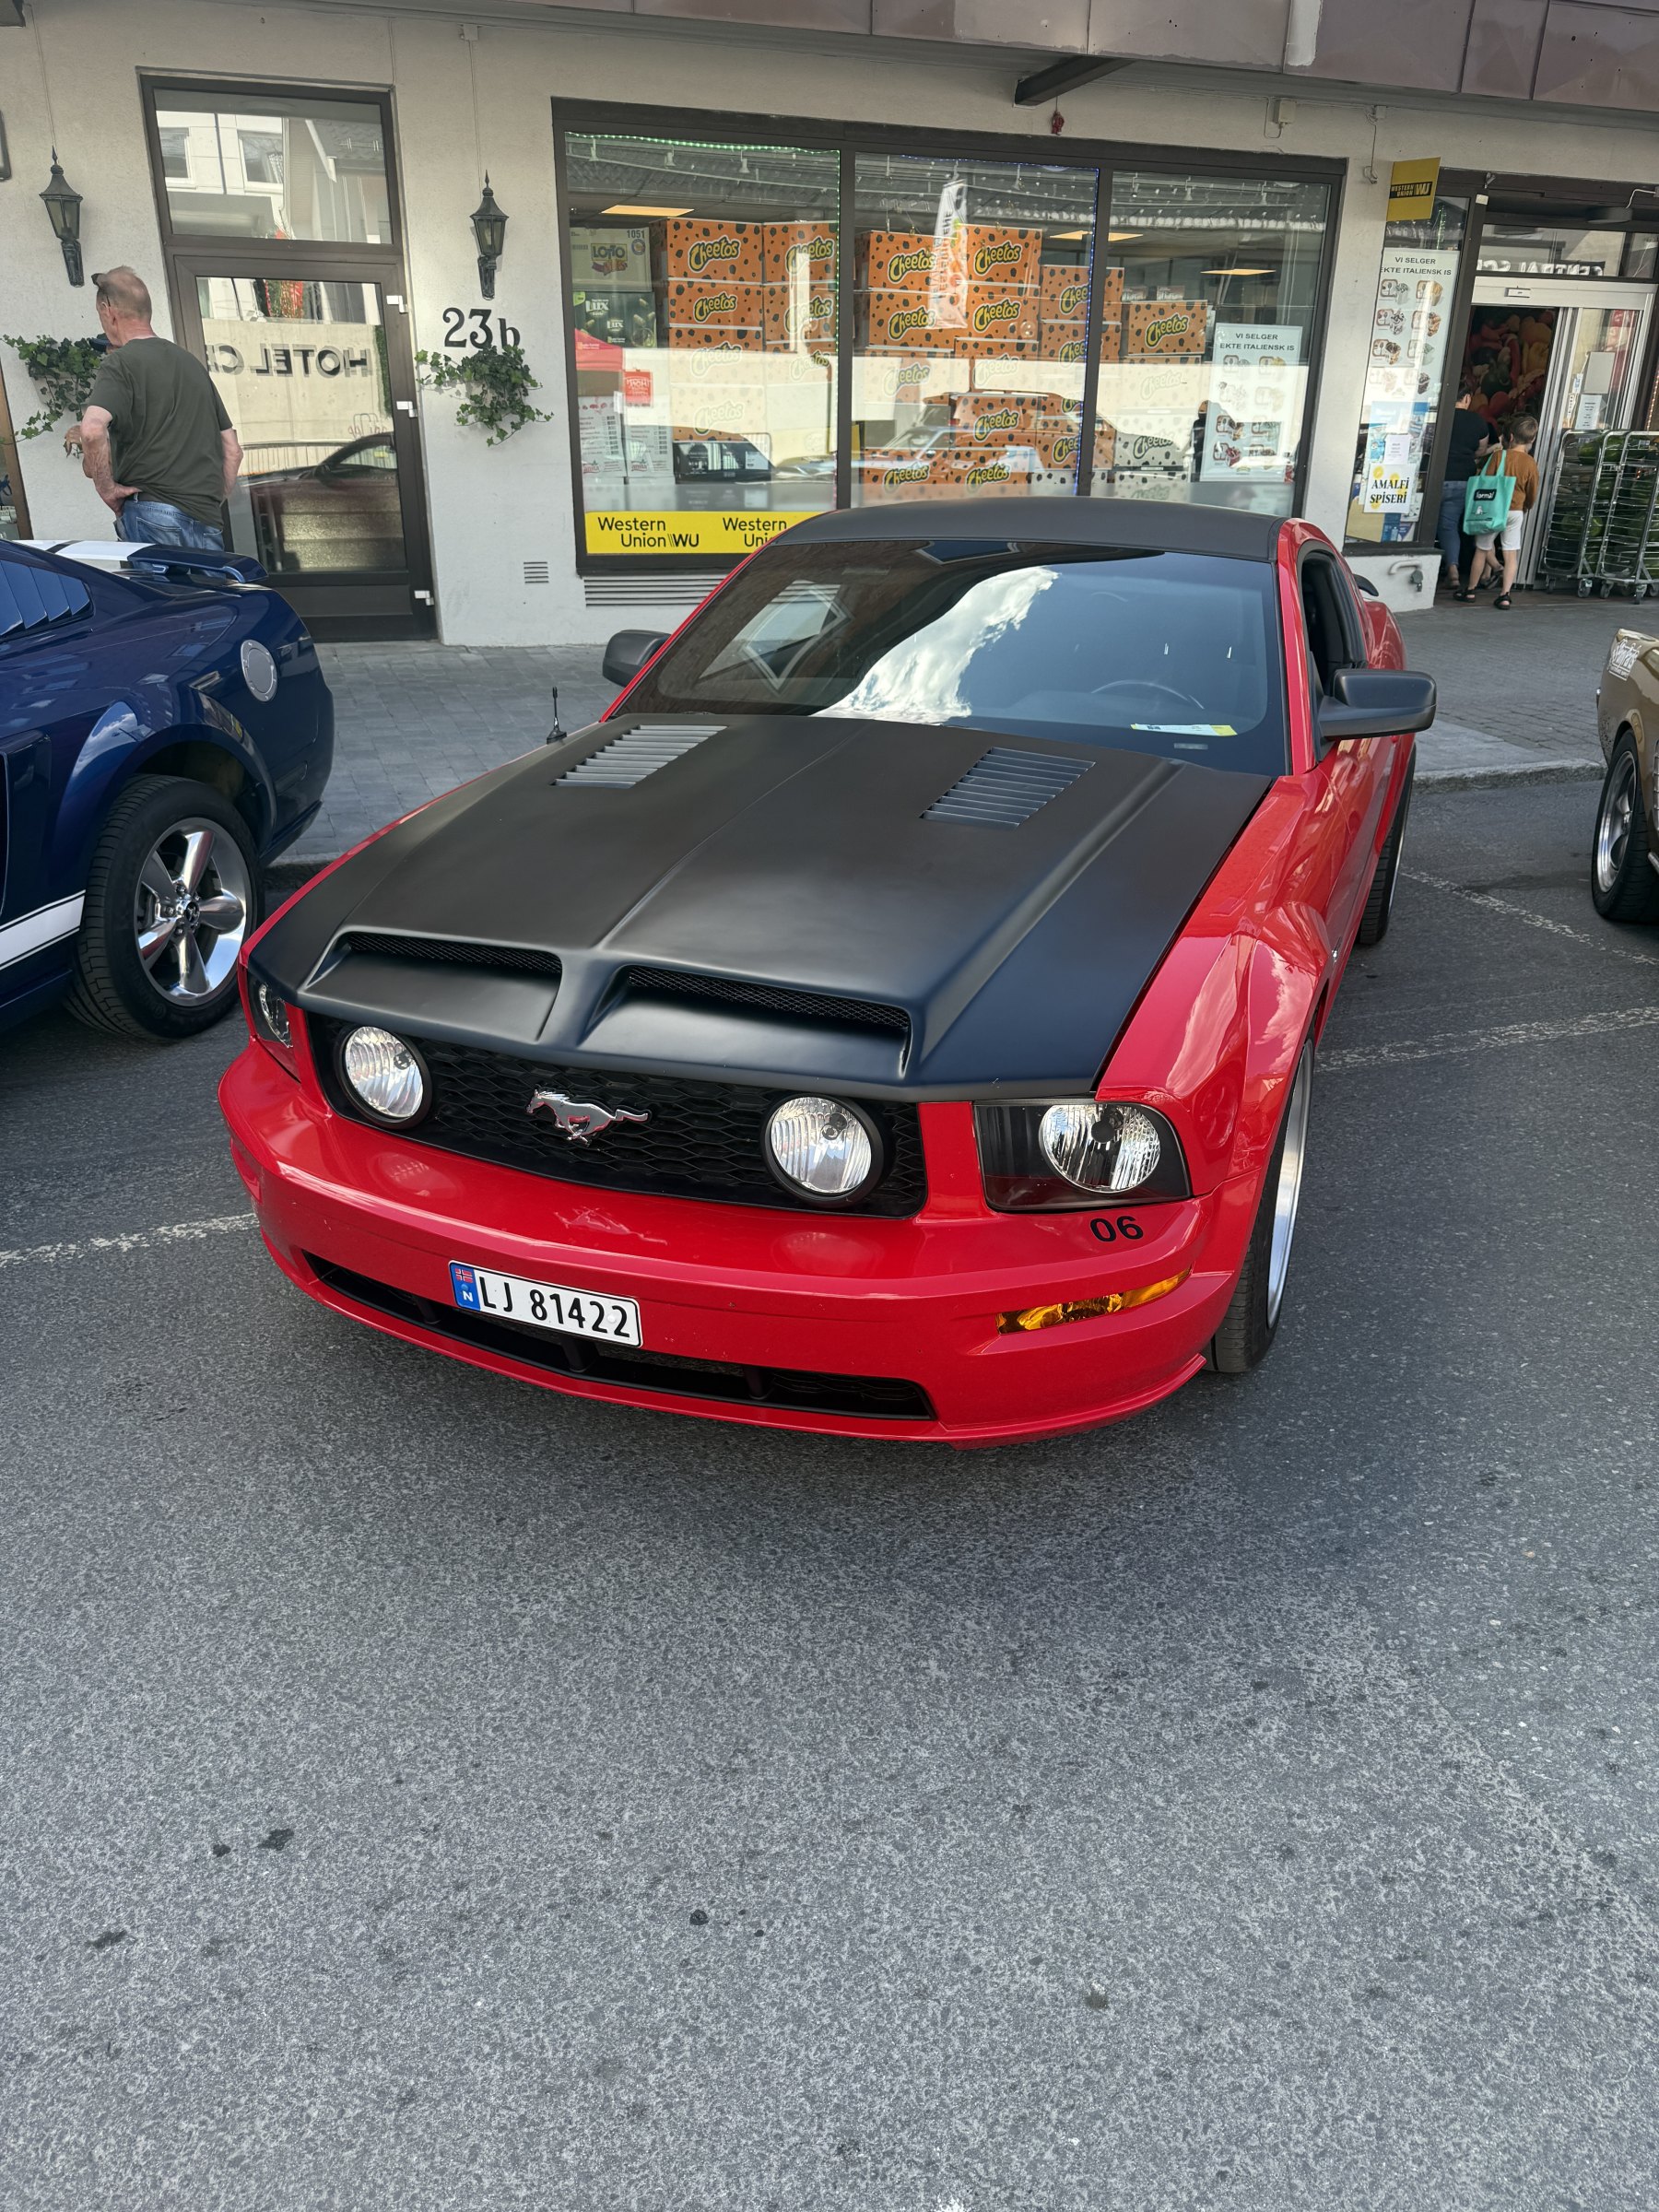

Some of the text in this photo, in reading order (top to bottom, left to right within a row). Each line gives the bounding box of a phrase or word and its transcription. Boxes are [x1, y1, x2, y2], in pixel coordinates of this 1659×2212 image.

[1416, 182, 1430, 195] WU
[627, 229, 645, 239] 1051
[689, 237, 740, 272] Cheetos
[888, 250, 935, 282] Cheetos
[975, 241, 1021, 275] Cheetos
[694, 291, 736, 323] Cheetos
[1060, 285, 1089, 314] Chee
[889, 307, 935, 339] Cheetos
[973, 299, 1019, 332] Cheetos
[1146, 314, 1189, 347] Cheetos
[1059, 341, 1086, 368] Chee
[885, 363, 930, 395] Cheetos
[974, 409, 1019, 441] Cheetos
[1053, 436, 1080, 463] Chee
[884, 463, 930, 493] Cheetos
[967, 464, 1010, 493] Cheetos
[598, 517, 665, 531] Western
[723, 517, 787, 532] Western
[621, 533, 665, 547] Union
[745, 533, 774, 547] Uni
[1090, 1216, 1144, 1242] 06
[463, 1290, 473, 1302] N
[479, 1277, 630, 1338] LJ 81422
